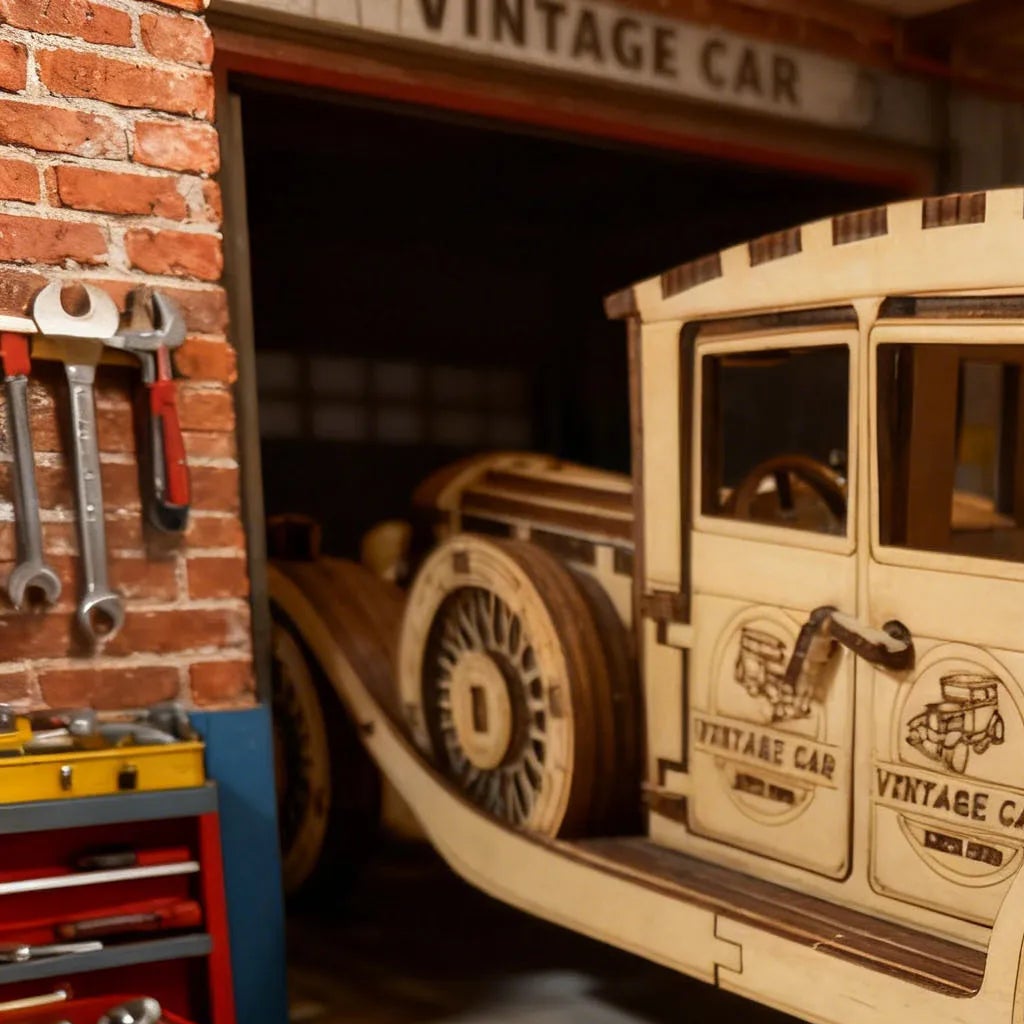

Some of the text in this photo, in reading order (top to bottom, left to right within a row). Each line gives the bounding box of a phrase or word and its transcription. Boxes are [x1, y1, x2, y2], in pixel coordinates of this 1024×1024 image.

[417, 0, 799, 105] VINTAGE CAR
[794, 744, 837, 780] CAR
[877, 768, 990, 821] VINTAGE
